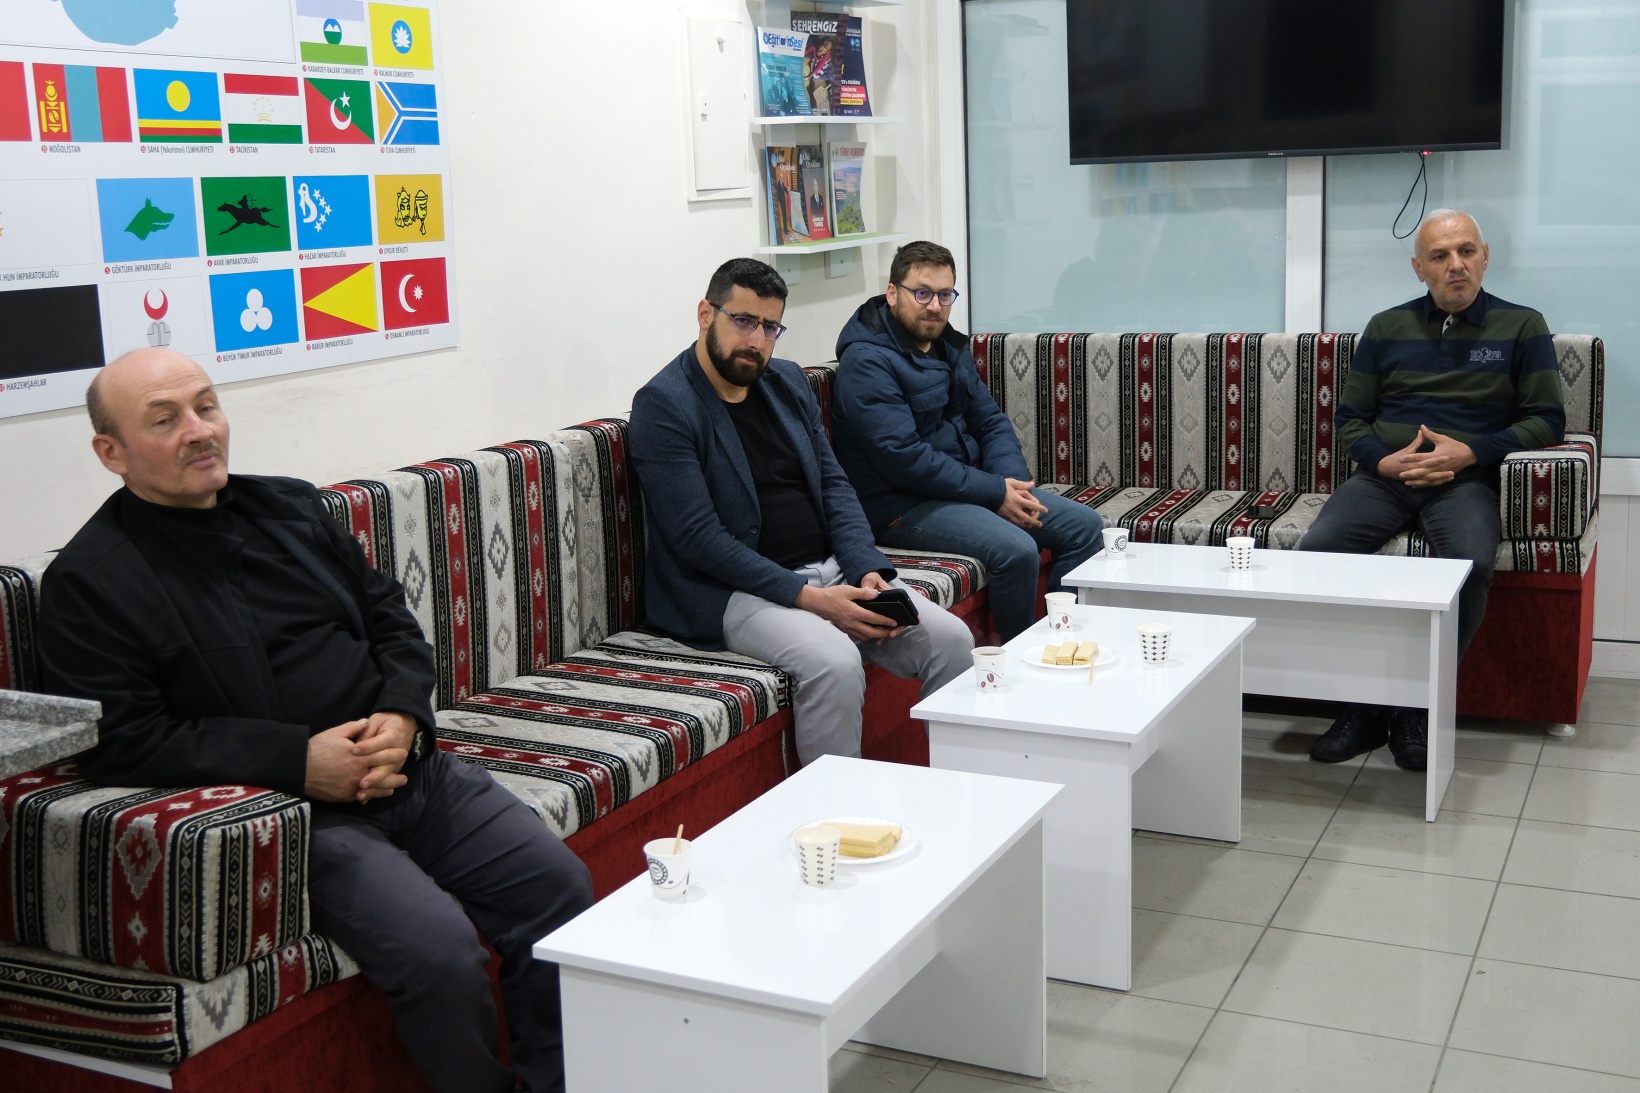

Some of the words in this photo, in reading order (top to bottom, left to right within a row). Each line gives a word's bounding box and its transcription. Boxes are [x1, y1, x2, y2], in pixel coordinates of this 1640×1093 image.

[341, 67, 364, 75] CUMHURİYETİ
[49, 144, 81, 153] MOĞOLİSTAN
[148, 145, 159, 153] SAHA
[186, 144, 214, 153] CUMHURİYETİ
[236, 145, 258, 153] TACİKİSTAN
[314, 145, 335, 153] TATARİSTAN
[214, 258, 224, 266] AVAR
[225, 255, 258, 265] İMPARATORLUĞU
[305, 252, 317, 260] HAZAR
[111, 263, 134, 274] GÖKTÜRK
[134, 261, 171, 272] İMPARATORLUĞU
[16, 268, 59, 280] İMPARATORLUĞU
[223, 352, 236, 362] BÜYÜK
[237, 352, 250, 360] TİMUR
[251, 347, 282, 358] İMPARATORLUĞU
[6, 379, 47, 391] HARZEMŞAHLAR
